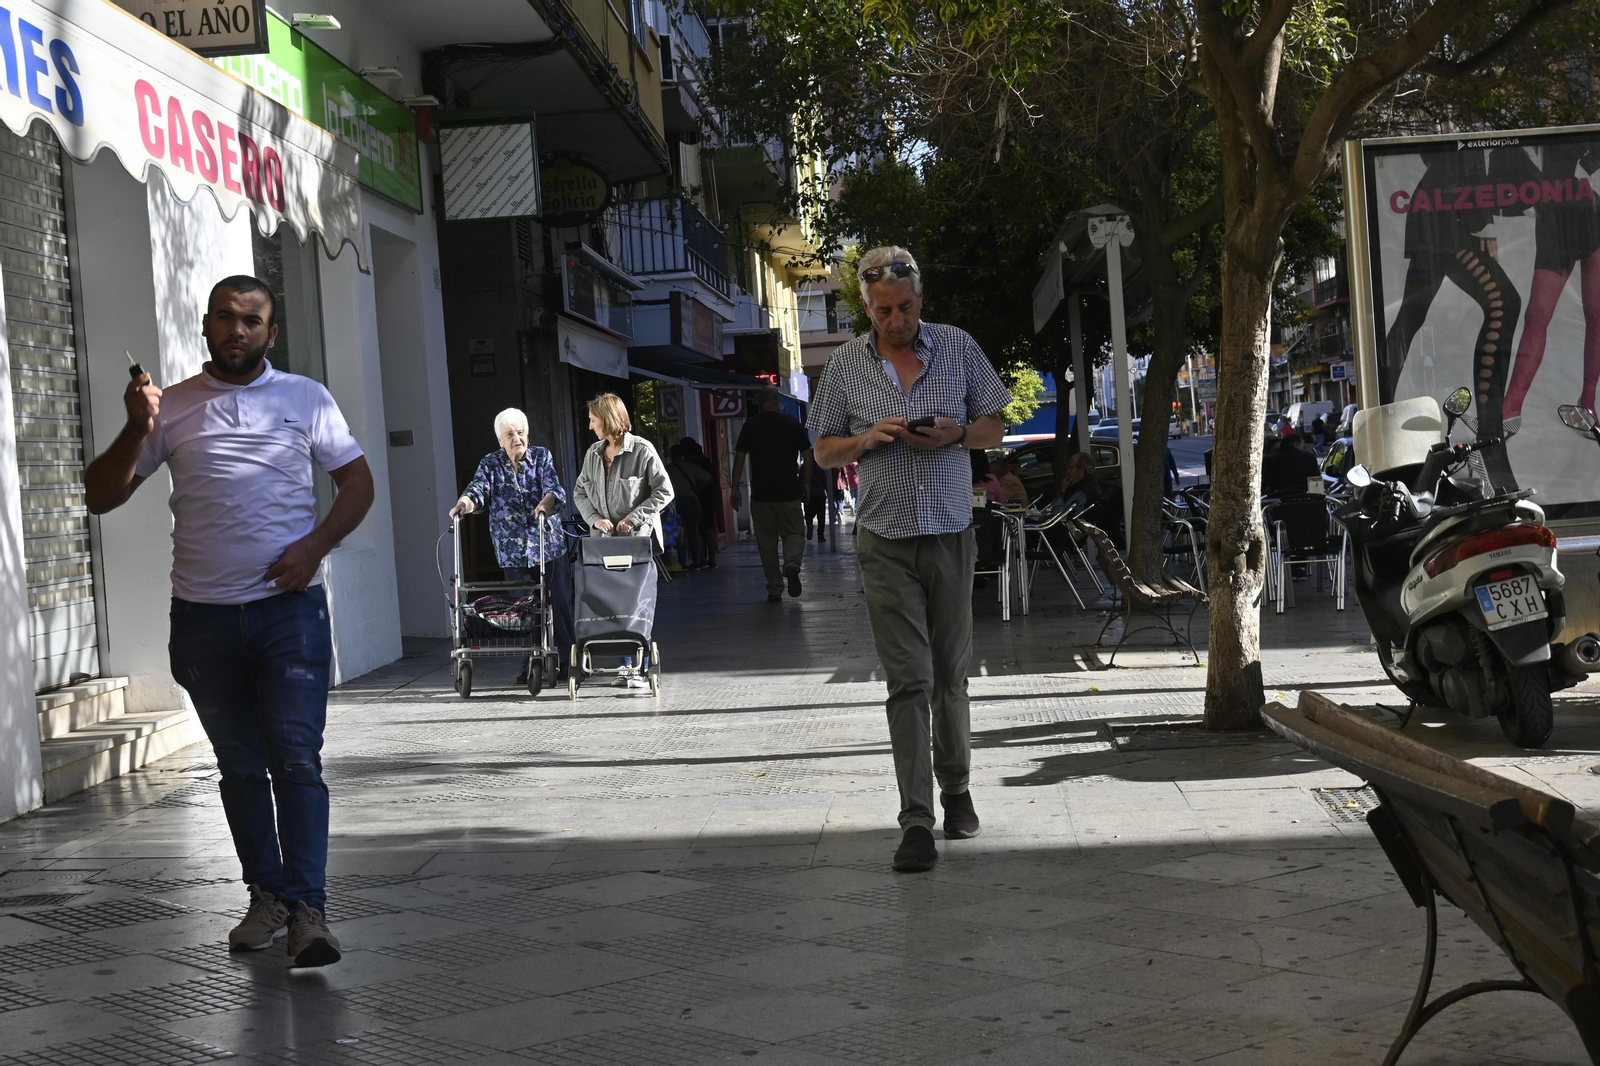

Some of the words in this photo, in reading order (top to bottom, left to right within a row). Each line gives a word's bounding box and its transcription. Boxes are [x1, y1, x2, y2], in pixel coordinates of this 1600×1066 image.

[163, 9, 192, 37] EL
[197, 0, 250, 36] AÑO
[134, 78, 285, 214] CASERO
[1467, 137, 1519, 148] exteriorplus
[543, 175, 597, 193] strella
[1389, 177, 1593, 214] CALZEDONIA
[1488, 549, 1512, 560] YAMAHA
[1489, 577, 1530, 601] 5687
